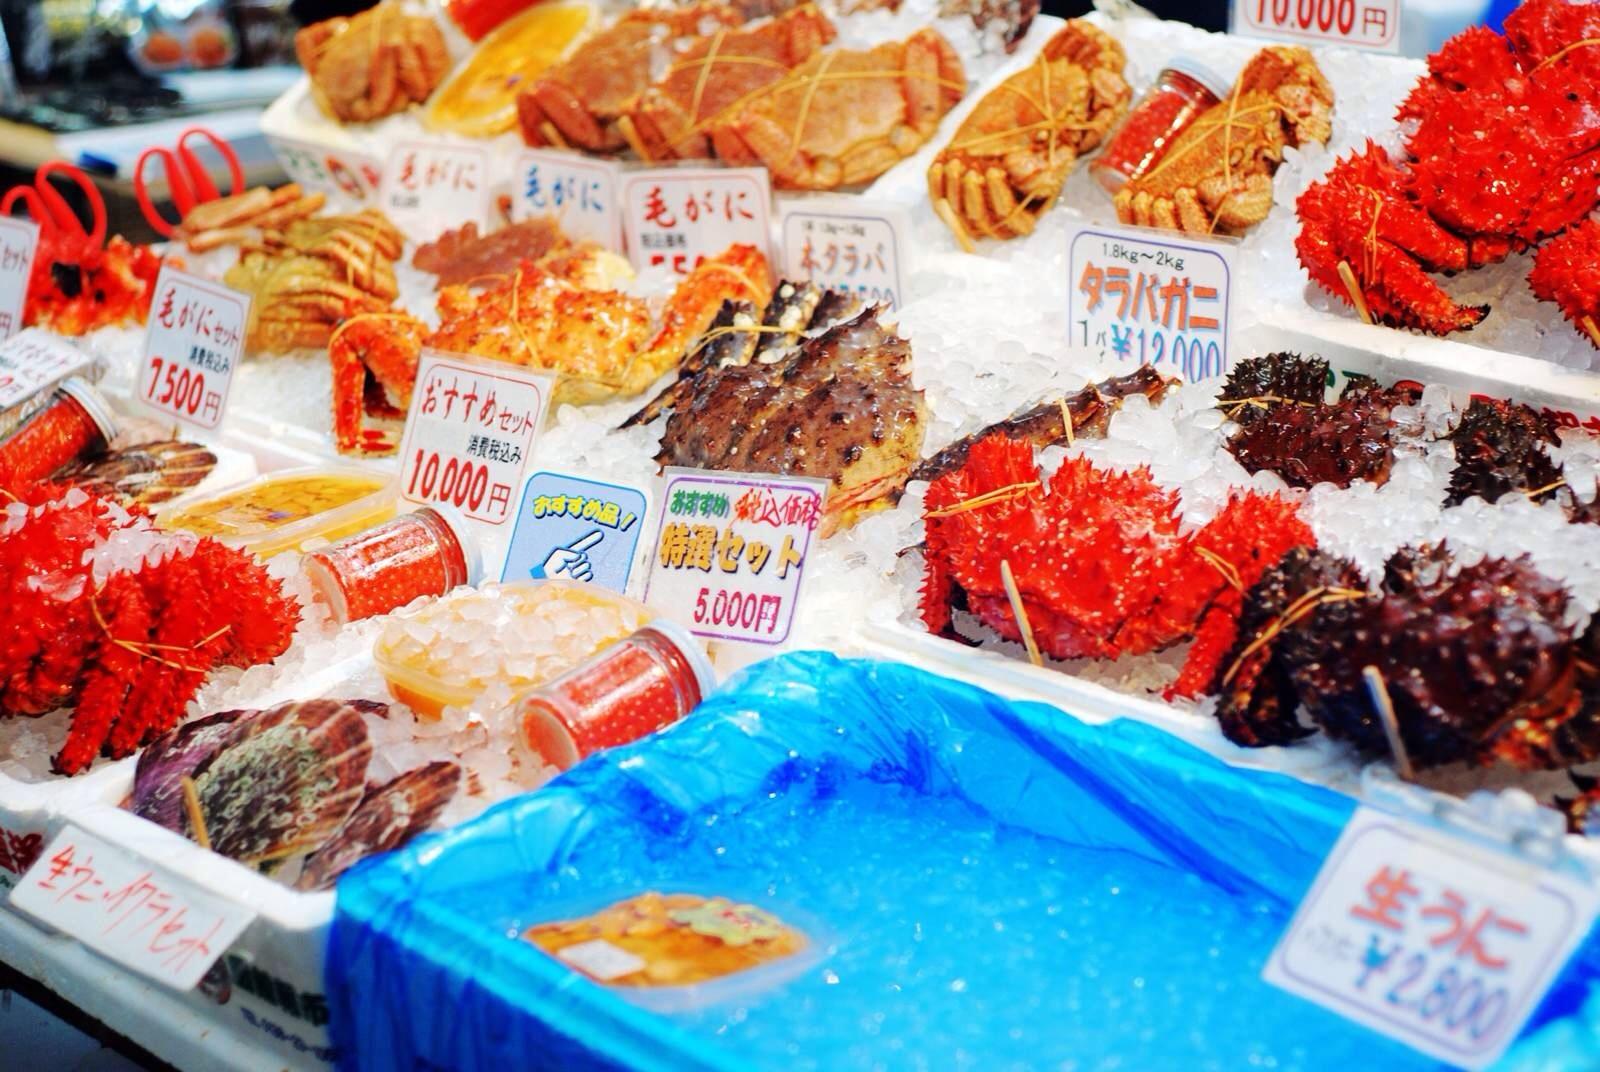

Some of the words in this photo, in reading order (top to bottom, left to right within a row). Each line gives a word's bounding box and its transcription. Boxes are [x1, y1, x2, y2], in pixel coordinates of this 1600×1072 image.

[400, 152, 476, 191] 毛がに
[525, 165, 604, 211] 毛がに
[644, 185, 754, 228] 毛がに
[158, 288, 239, 347] 毛がにセット
[1079, 260, 1220, 334] タラバガニ
[421, 376, 533, 436] おすすめセット
[467, 433, 522, 465] 消費税込み
[408, 448, 512, 516] 10.000円
[670, 488, 731, 519] おすすめ
[733, 487, 823, 531] 税込価格
[659, 521, 806, 580] 特選セット
[693, 587, 782, 634] 5.000円
[1349, 863, 1530, 971] 生うに
